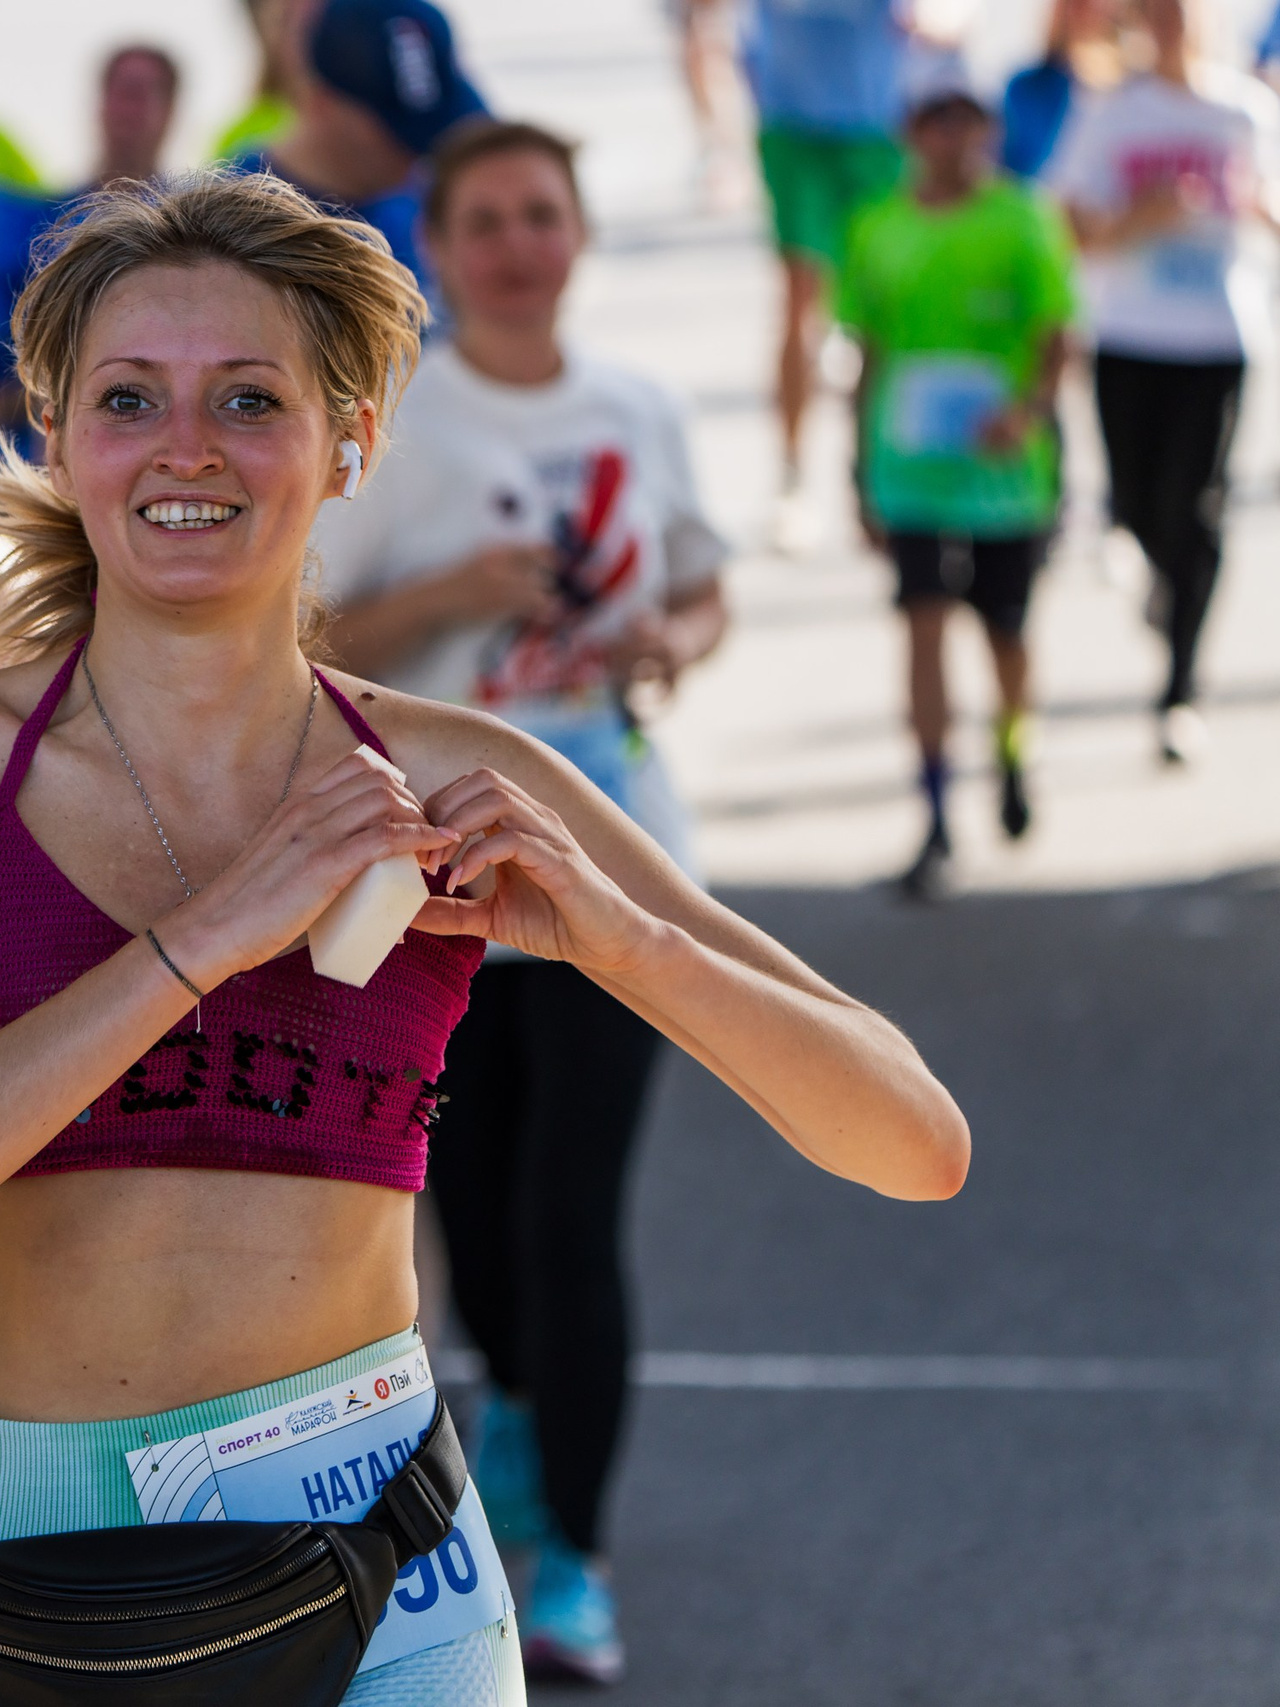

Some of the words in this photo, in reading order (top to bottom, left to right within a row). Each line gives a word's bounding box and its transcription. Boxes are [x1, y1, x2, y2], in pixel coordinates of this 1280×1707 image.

[389, 1369, 412, 1393] Пэй
[290, 1410, 338, 1437] МАРАФОН
[218, 1432, 262, 1455] СПОРТ
[264, 1426, 281, 1439] 40
[375, 1526, 479, 1627] 90
